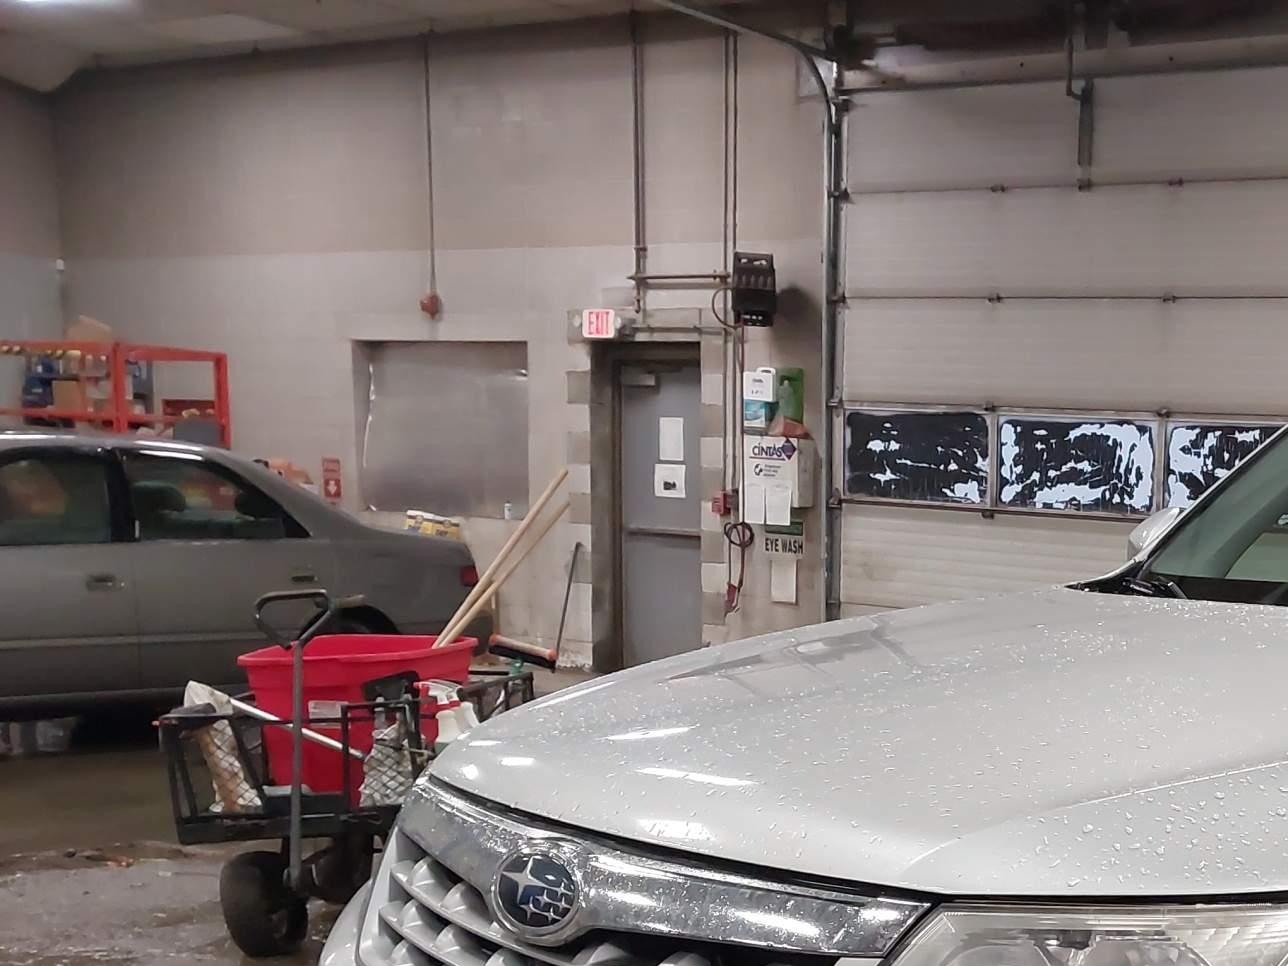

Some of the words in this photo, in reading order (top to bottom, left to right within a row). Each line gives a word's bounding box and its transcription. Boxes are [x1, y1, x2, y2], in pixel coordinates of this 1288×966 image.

[588, 311, 610, 336] EXIT
[765, 537, 780, 553] EYE
[781, 538, 804, 555] WASH
